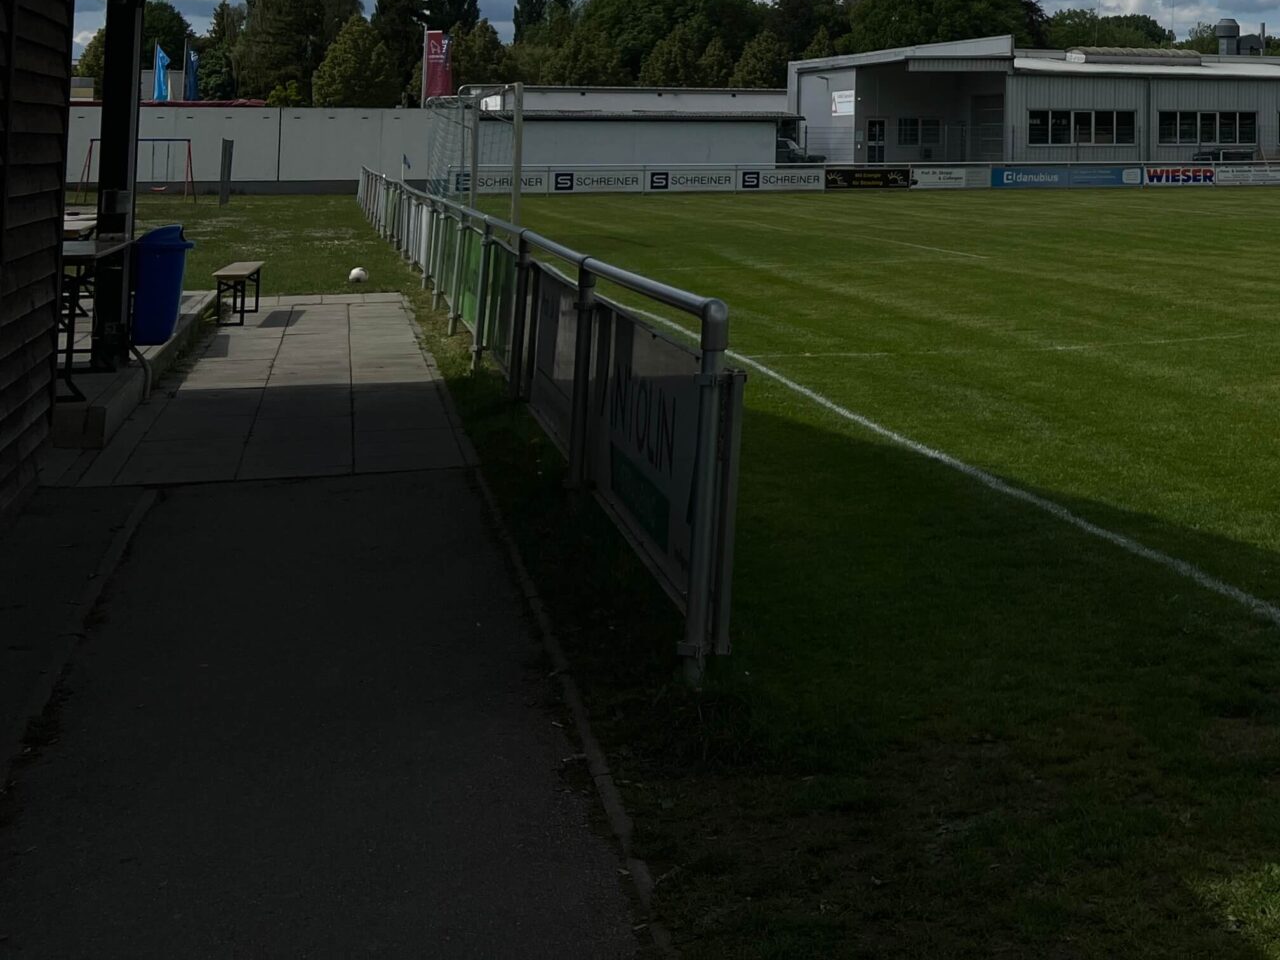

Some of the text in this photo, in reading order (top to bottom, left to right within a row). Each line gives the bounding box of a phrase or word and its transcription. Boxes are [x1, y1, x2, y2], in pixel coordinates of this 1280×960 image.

[670, 175, 731, 185] SCHREINER
[761, 174, 820, 185] SCHREINER
[1016, 171, 1059, 183] danubius
[1146, 168, 1215, 183] WIESER
[478, 177, 543, 187] SCHRNER
[575, 176, 640, 187] SCHREINER
